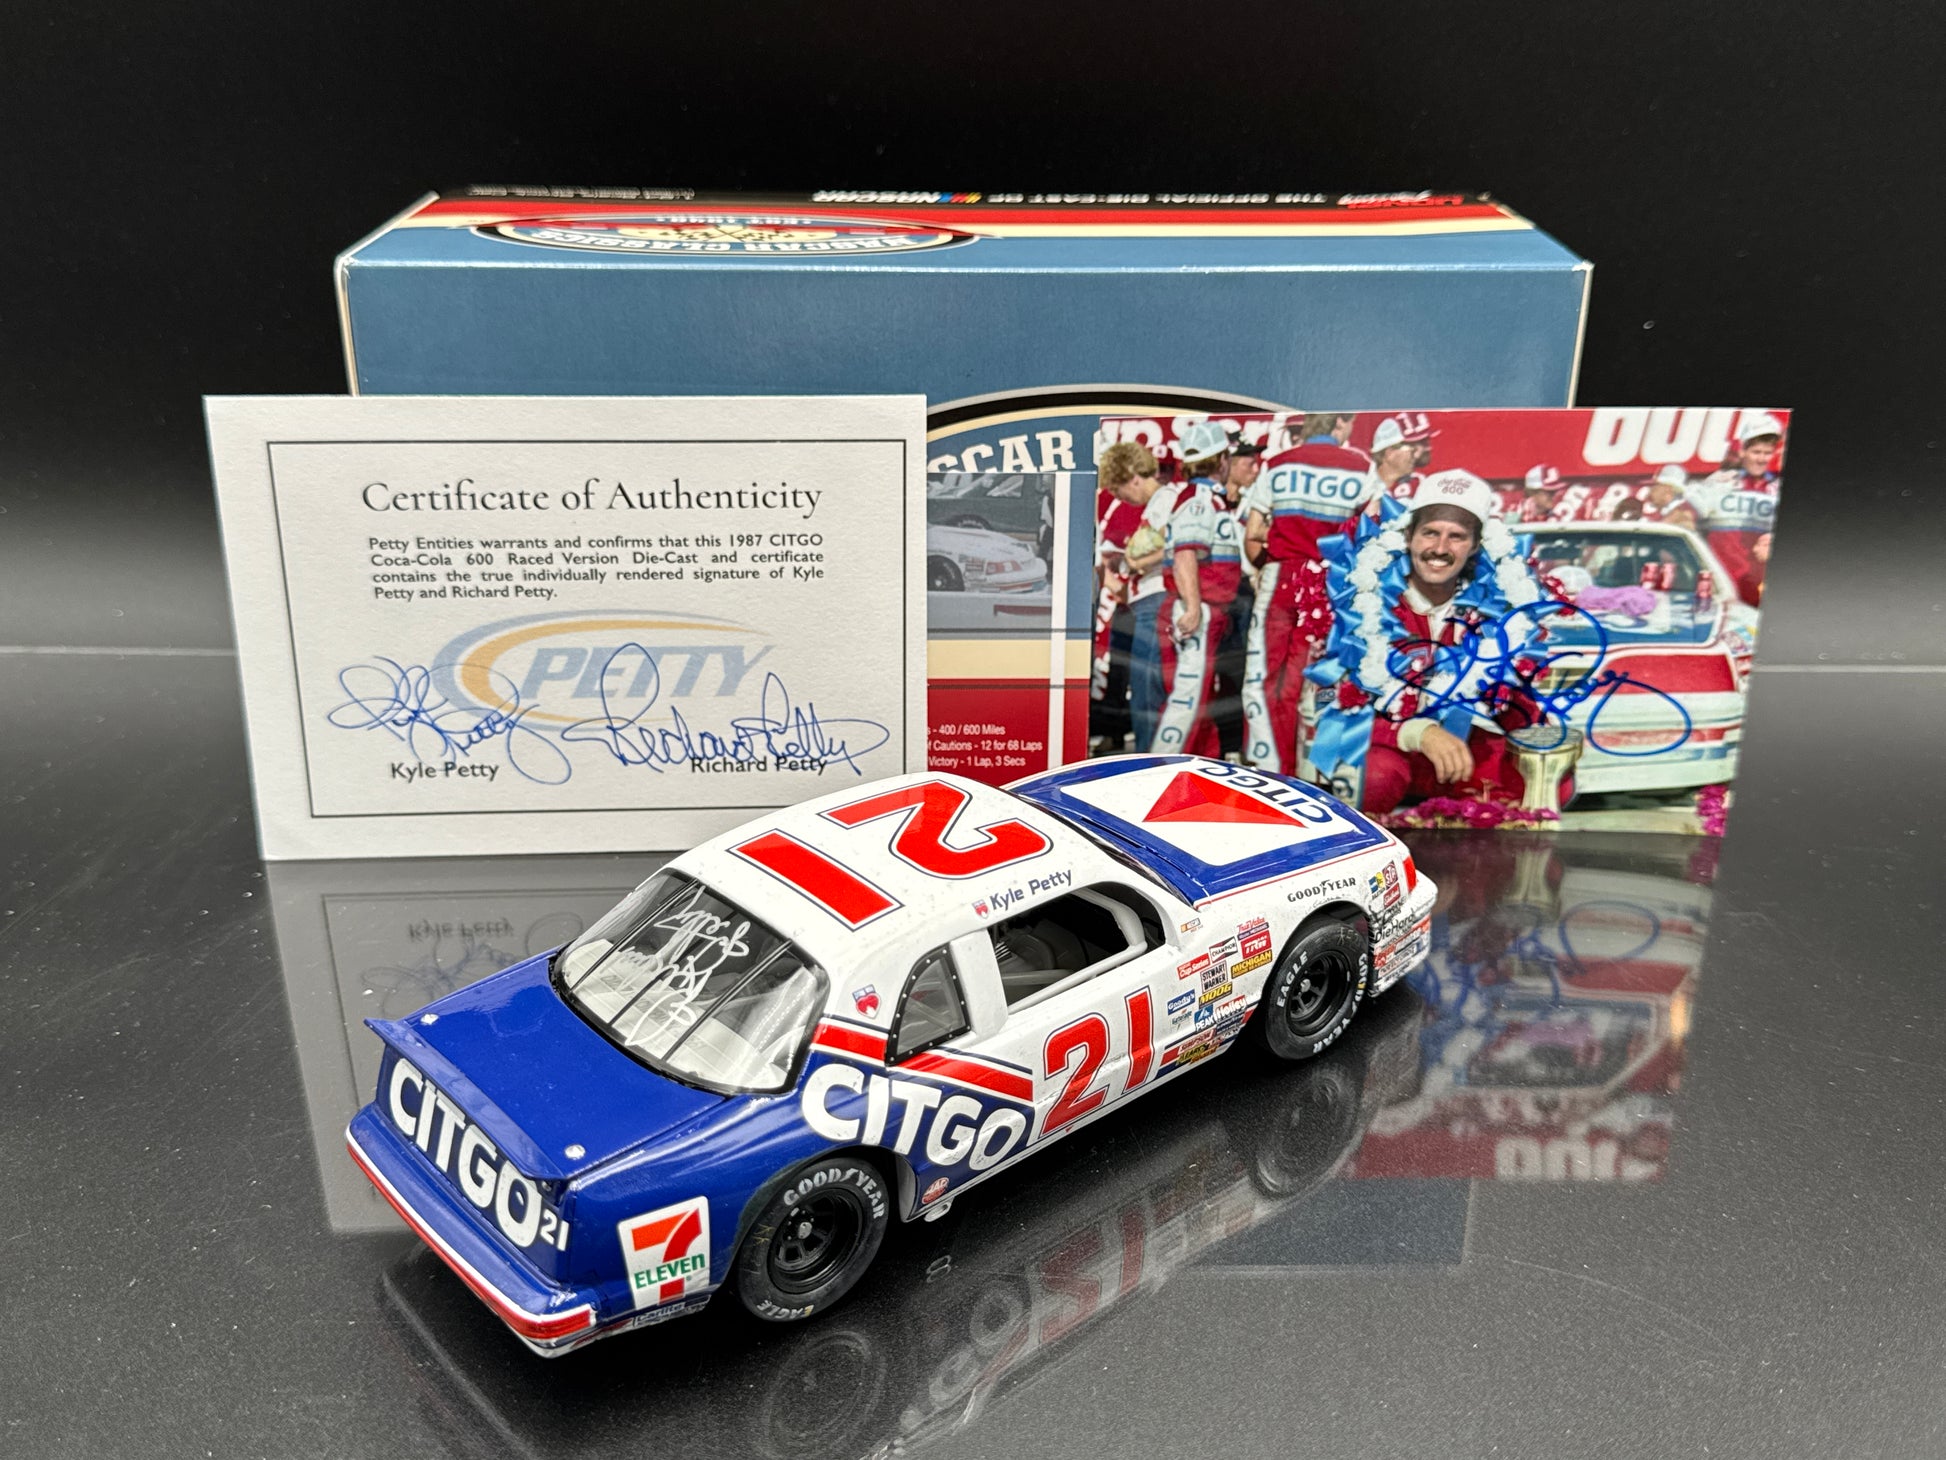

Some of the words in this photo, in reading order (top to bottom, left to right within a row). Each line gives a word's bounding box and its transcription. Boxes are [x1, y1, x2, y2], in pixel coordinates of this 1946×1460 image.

[531, 230, 732, 252] CLASSICS
[743, 236, 918, 252] NASCAR
[1271, 470, 1363, 500] CITGO
[362, 477, 549, 512] Certificate
[562, 477, 600, 510] of
[609, 477, 823, 520] Authenticity
[369, 538, 409, 554] Petty
[415, 537, 474, 550] Entities
[479, 538, 548, 550] warrants
[554, 536, 582, 549] and
[588, 535, 652, 549] confirms
[659, 535, 689, 548] that
[695, 535, 722, 548] this
[729, 534, 763, 547] 1987
[769, 533, 824, 547] CITGO
[371, 552, 453, 567] Coca-Cola
[466, 553, 494, 565] 600
[508, 553, 554, 566] Raced
[561, 552, 619, 565] Version
[633, 551, 698, 565] Die-Cast
[711, 551, 738, 564] and
[751, 550, 824, 565] certificate
[372, 570, 436, 584] contains
[446, 570, 471, 583] the
[480, 571, 513, 583] true
[523, 568, 606, 585] individually
[616, 568, 683, 582] rendered
[693, 567, 760, 584] signature
[769, 566, 785, 580] of
[793, 566, 825, 583] Kyle
[374, 586, 414, 603] Petty
[420, 586, 447, 600] and
[452, 585, 509, 600] Richard
[514, 584, 558, 602] Petty.
[520, 645, 777, 699] PETTY
[938, 724, 956, 735] 400
[963, 724, 981, 735] 600
[981, 724, 1006, 735] Miles
[933, 740, 972, 751] Cautions
[980, 740, 992, 751] 12
[993, 740, 1006, 751] for
[1007, 740, 1019, 751] 68
[1020, 740, 1043, 752] Laps
[390, 762, 437, 783] Kyle
[444, 761, 500, 783] Petty
[691, 755, 768, 774] Richard
[775, 756, 828, 775] Petty
[929, 756, 959, 768] Victory
[973, 756, 995, 768] Lap,
[995, 756, 1002, 766] 3
[1003, 756, 1026, 767] Secs
[1197, 766, 1333, 823] CITGO
[726, 779, 1055, 932] 21
[989, 888, 1025, 913] Kyle
[1028, 868, 1073, 896] Petty
[1232, 950, 1272, 972] MICHIGAN
[1203, 975, 1227, 991] WARNER
[1277, 951, 1309, 1008] EAGLE
[1200, 983, 1232, 1005] MOOG
[1216, 998, 1247, 1018] Holley
[1195, 1016, 1216, 1033] PEAK
[1039, 985, 1155, 1138] 21
[801, 1063, 1027, 1171] CITGO
[389, 1059, 542, 1248] CITGO
[539, 1214, 568, 1251] 21
[631, 1208, 703, 1306] 7
[757, 1299, 815, 1320] EAGLE
